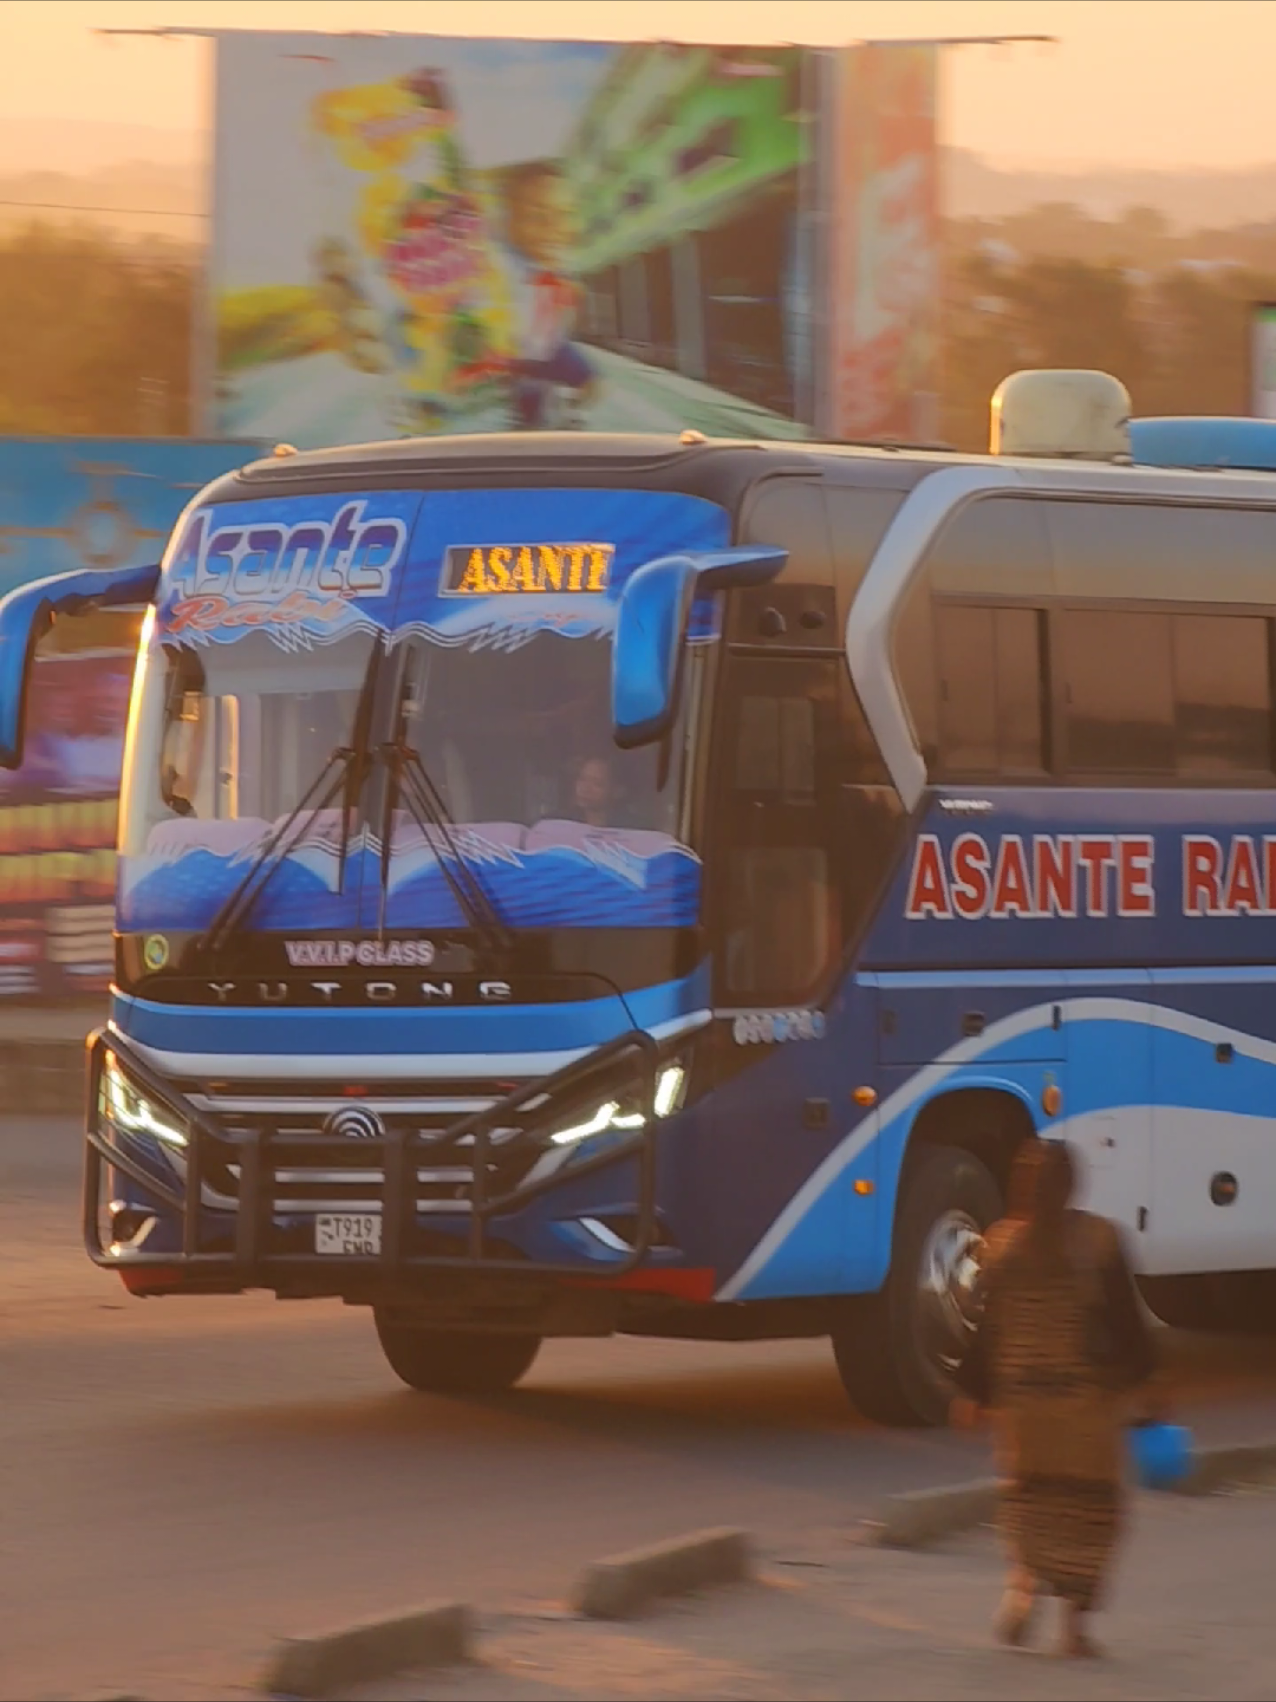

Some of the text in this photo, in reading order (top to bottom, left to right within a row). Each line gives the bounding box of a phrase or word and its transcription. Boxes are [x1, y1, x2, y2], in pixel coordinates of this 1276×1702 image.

[170, 499, 407, 597] Asante
[904, 832, 1156, 920] ASANTE
[207, 981, 511, 1000] YUTONG
[333, 1217, 373, 1238] T919
